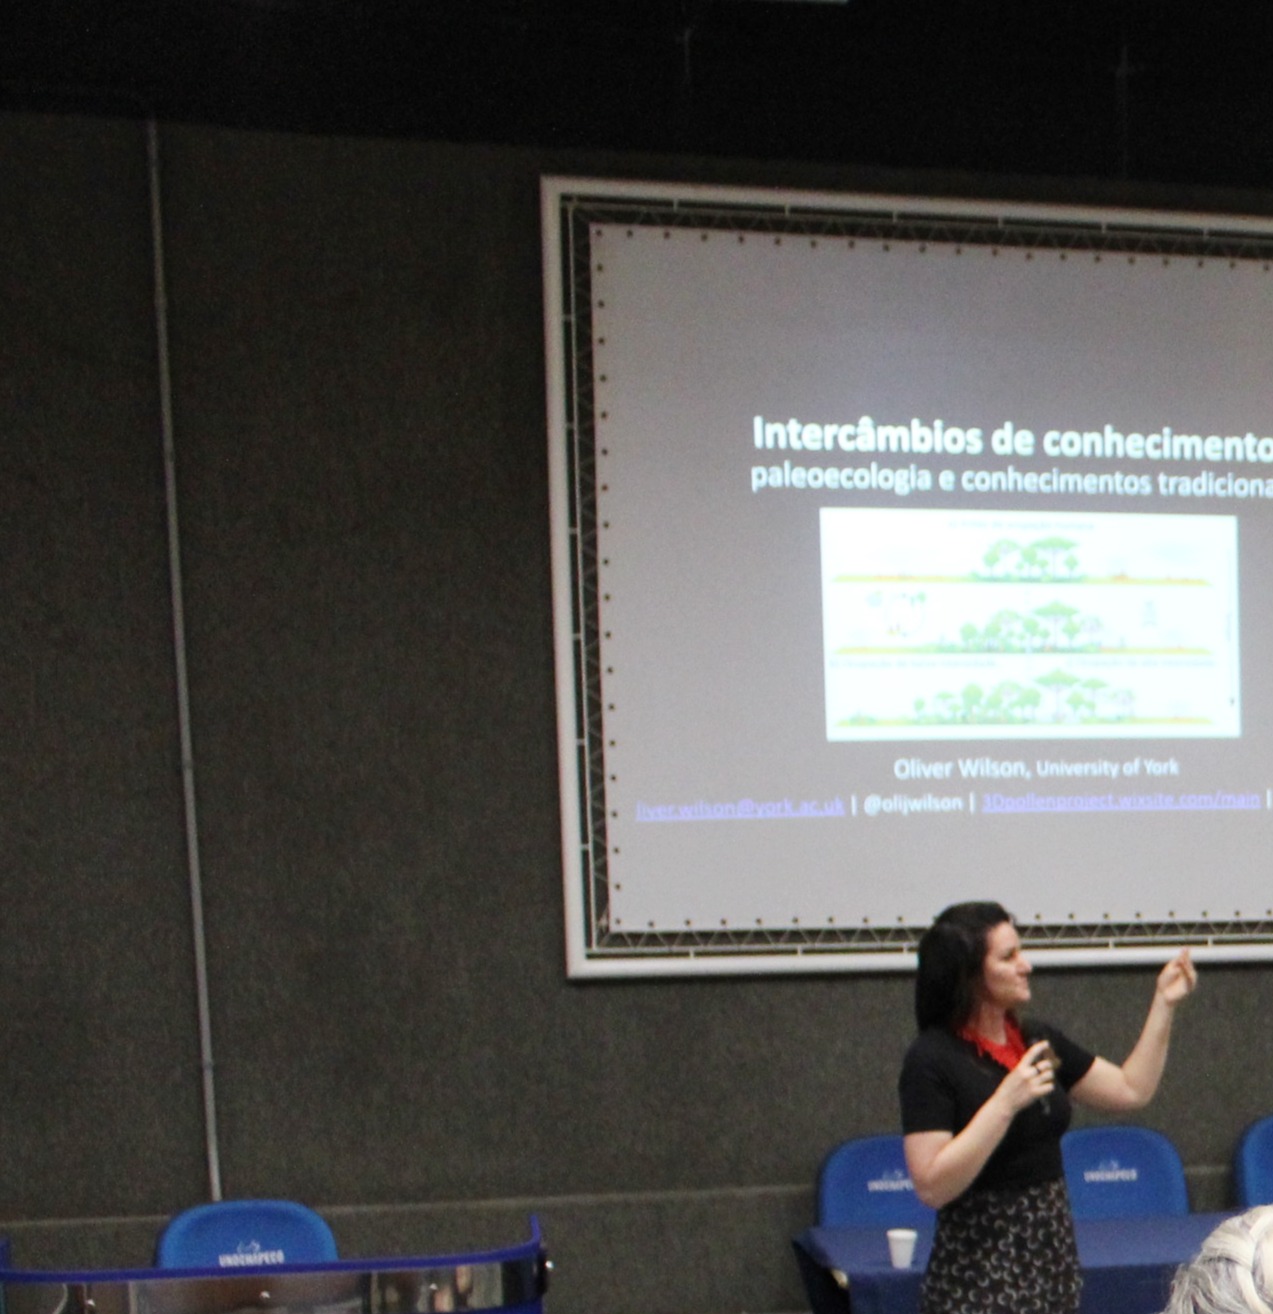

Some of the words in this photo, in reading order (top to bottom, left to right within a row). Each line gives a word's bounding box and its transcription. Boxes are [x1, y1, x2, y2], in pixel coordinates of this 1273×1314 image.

[753, 415, 983, 455] Intercâmbios
[991, 421, 1035, 456] de
[751, 460, 932, 496] paleoecologia
[938, 469, 956, 492] e
[961, 464, 1152, 496] conhecimentos
[893, 757, 953, 780] Oliver
[958, 757, 1032, 780] Wilson,
[1036, 758, 1118, 779] University
[1123, 757, 1141, 776] of
[1142, 758, 1179, 776] York
